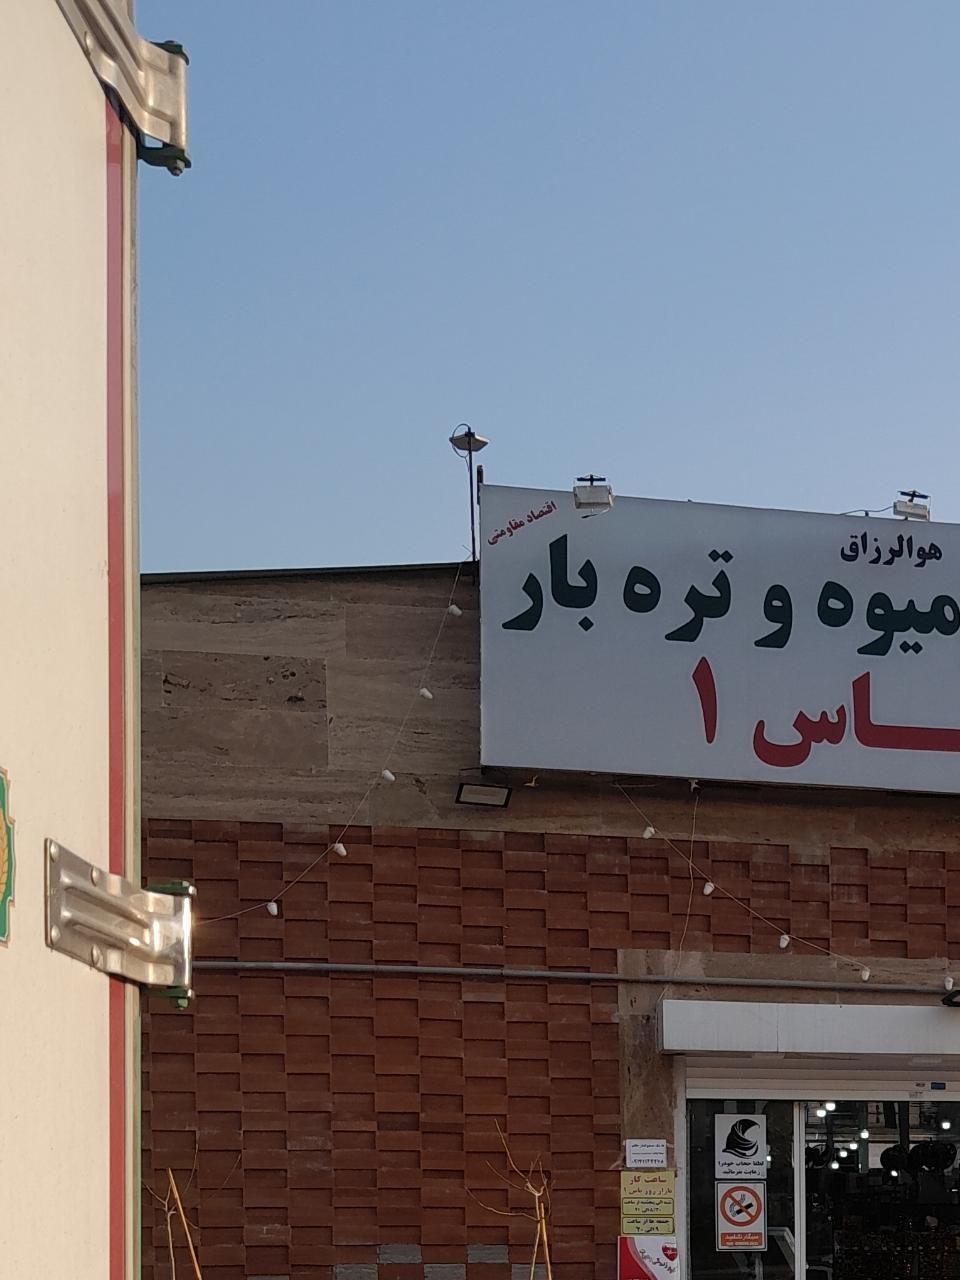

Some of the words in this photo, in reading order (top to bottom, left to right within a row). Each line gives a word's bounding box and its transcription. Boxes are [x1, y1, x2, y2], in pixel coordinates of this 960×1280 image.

[527, 501, 557, 523] اقتصاد
[488, 519, 525, 546] مقاومتی
[502, 533, 598, 632] بار
[623, 549, 732, 642] تره
[753, 584, 793, 649] و
[629, 1175, 641, 1186] کار
[644, 1175, 667, 1183] ساعت
